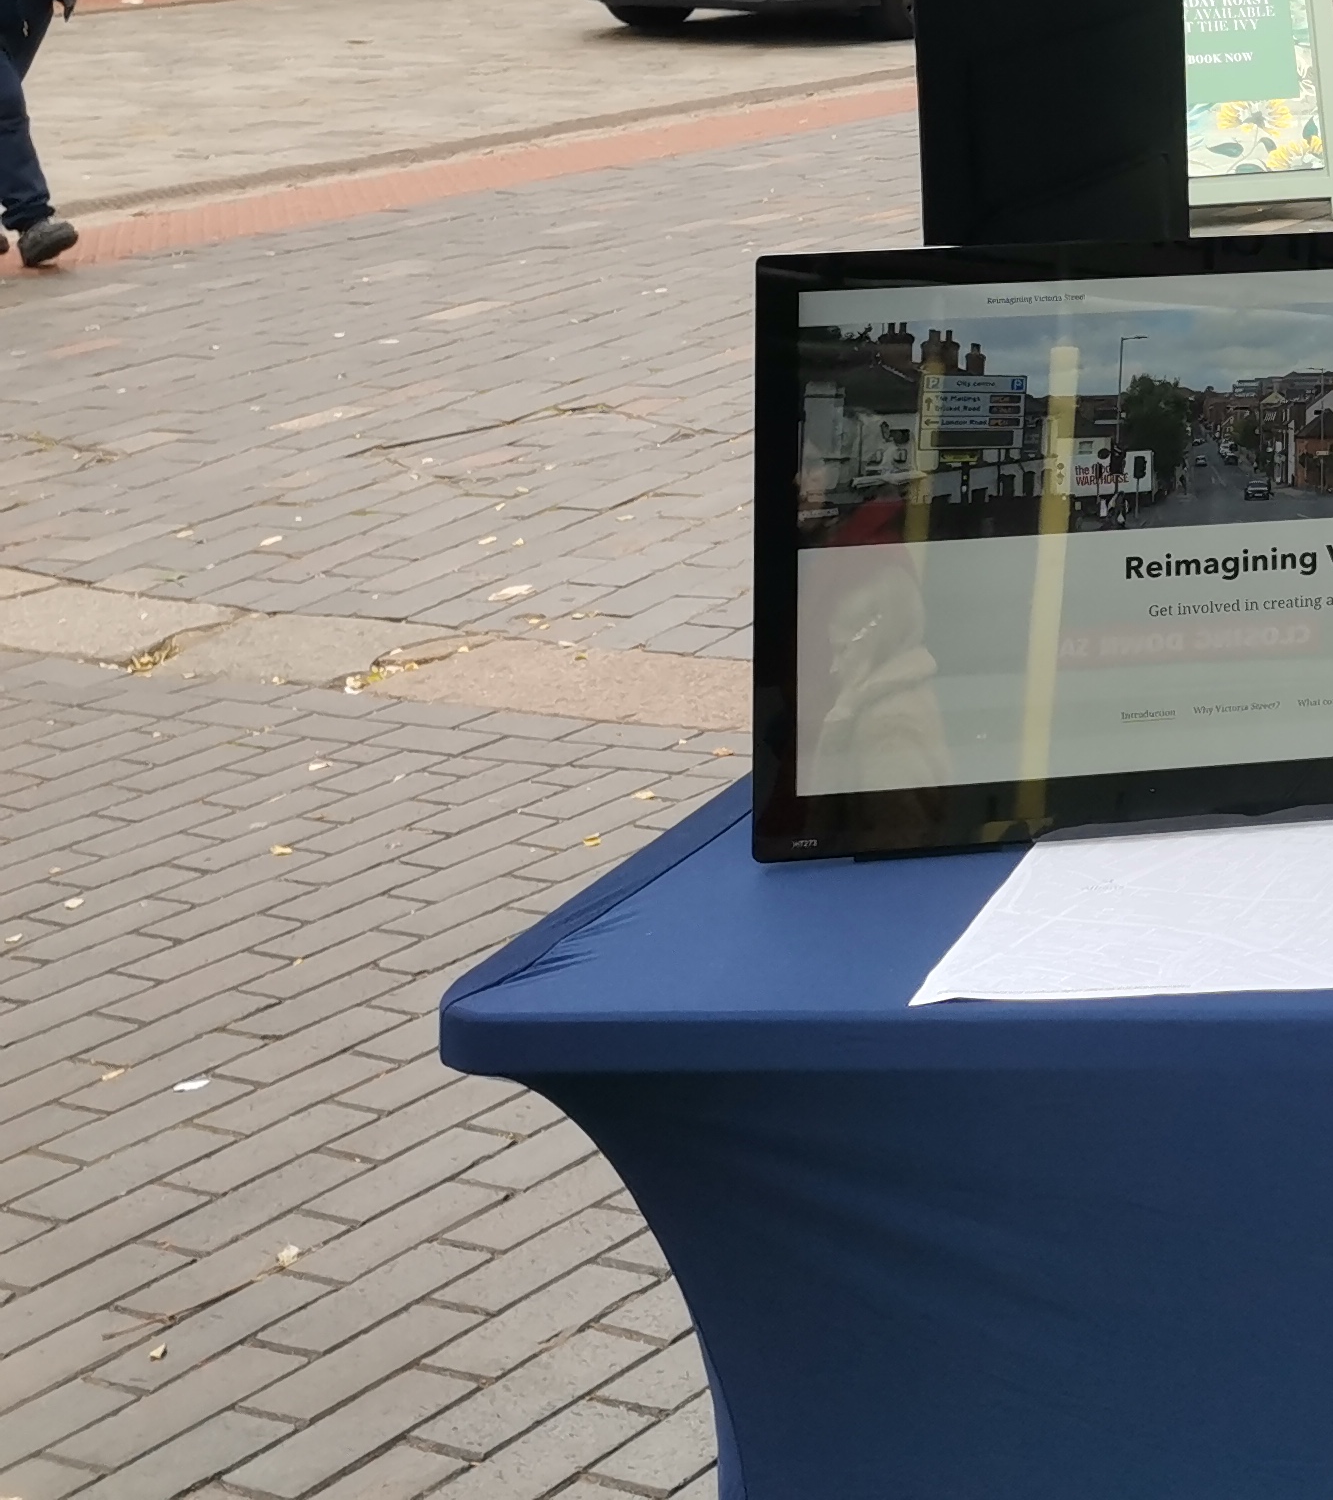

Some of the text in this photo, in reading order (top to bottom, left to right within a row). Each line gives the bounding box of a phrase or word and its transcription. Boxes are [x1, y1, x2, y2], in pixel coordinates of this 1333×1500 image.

[1194, 6, 1275, 21] AVAILABLE
[1197, 20, 1229, 33] THE
[1234, 19, 1259, 32] IVY
[1188, 51, 1253, 65] BOOK NOW
[987, 295, 1032, 305] Reimagining
[1034, 294, 1062, 303] Victoria
[1124, 547, 1318, 580] Reimagining
[1149, 603, 1173, 617] Get
[1178, 598, 1241, 615] involved
[1244, 598, 1259, 612] in
[1263, 595, 1322, 611] creating
[1193, 700, 1281, 716] Why Victoria Street?
[1298, 697, 1321, 707] What
[1121, 708, 1176, 720] Introduction
